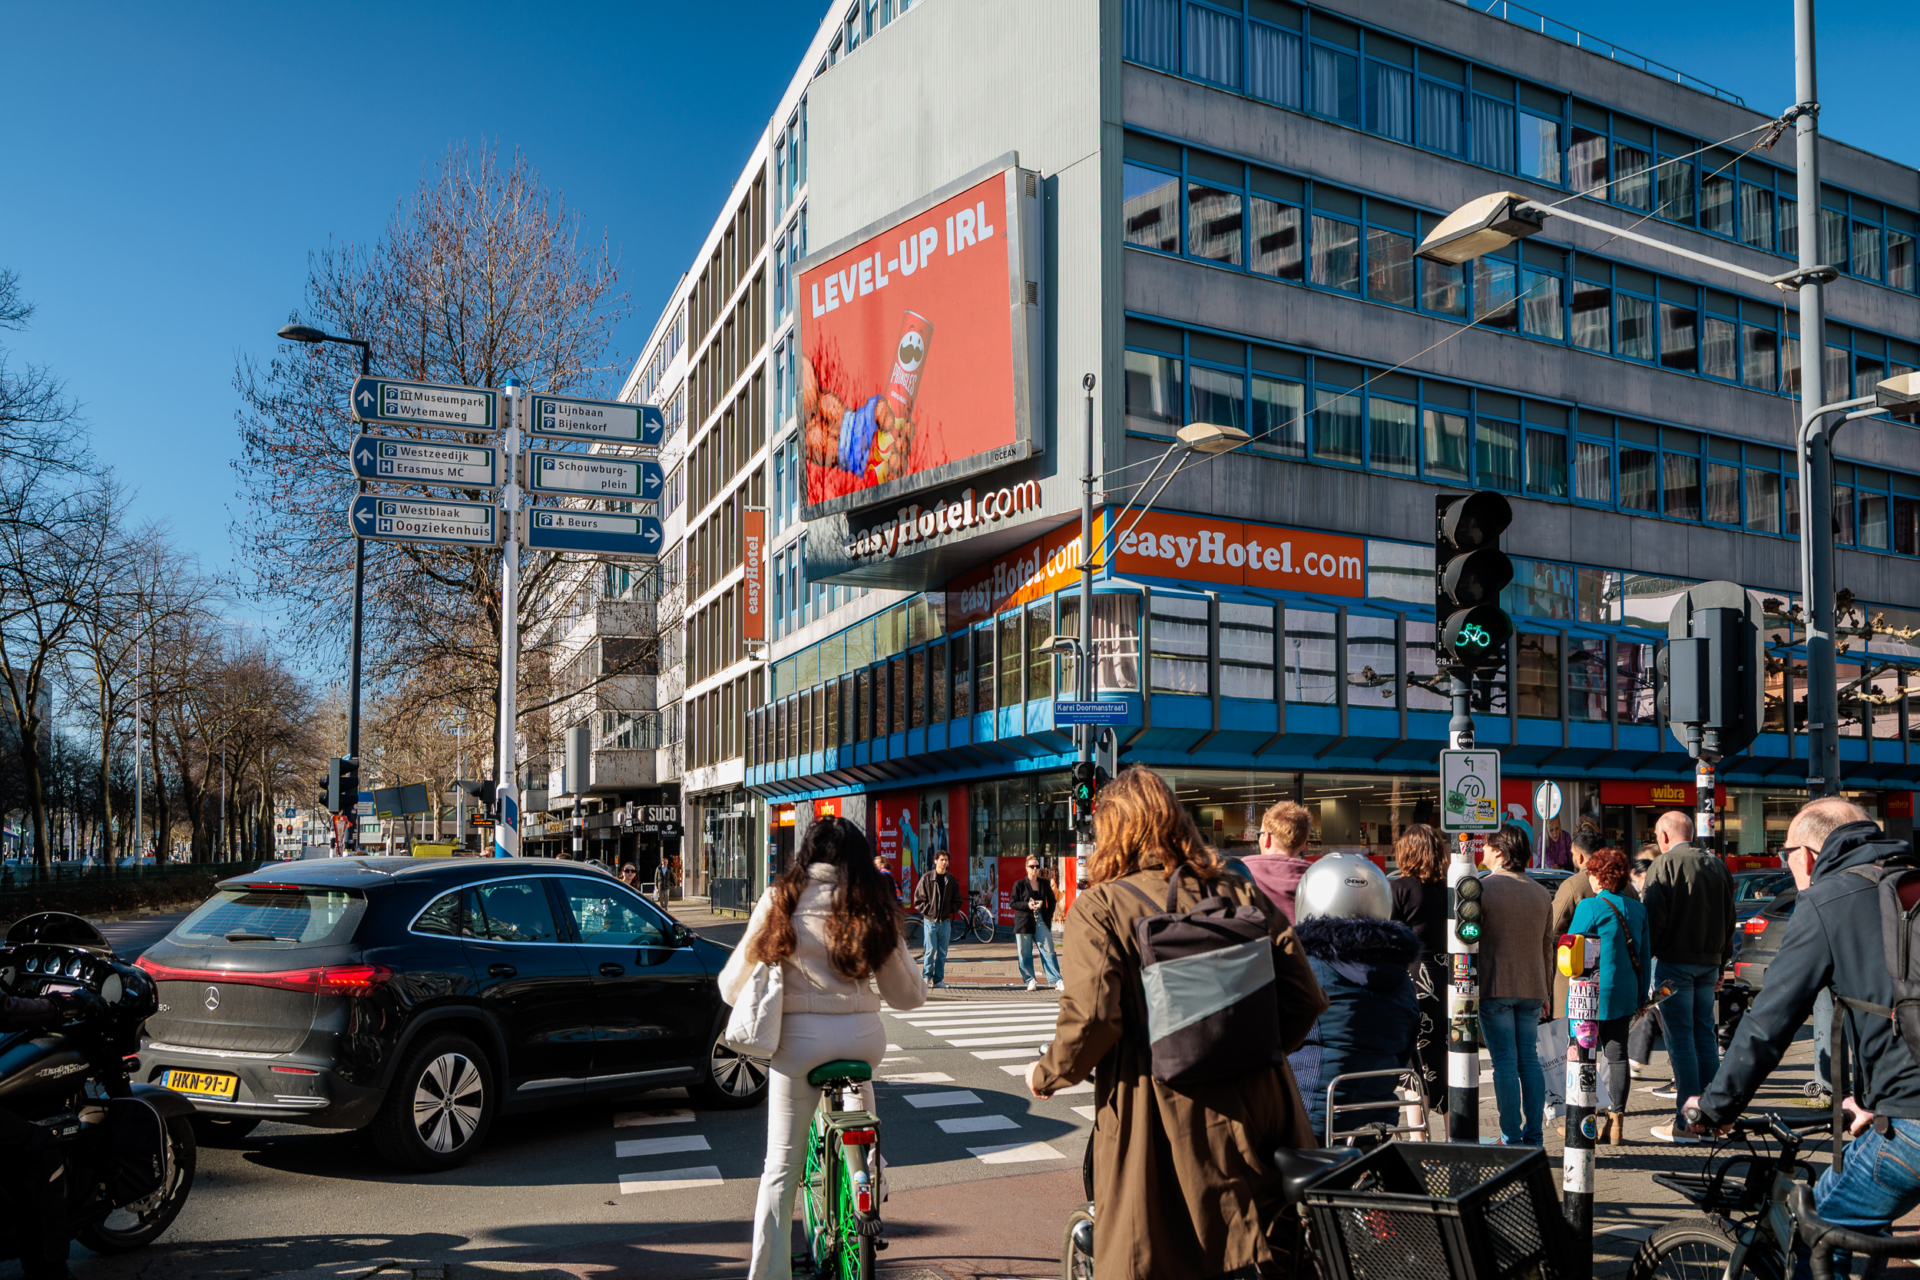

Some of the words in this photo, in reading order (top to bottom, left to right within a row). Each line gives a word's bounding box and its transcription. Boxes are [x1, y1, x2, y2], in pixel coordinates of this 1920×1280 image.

[812, 226, 938, 319] LEVEL-UP
[946, 200, 994, 256] IRL
[890, 362, 918, 396] PRINGLES
[414, 390, 484, 408] Museumpark
[400, 404, 467, 422] Wytemaweg
[558, 405, 604, 418] Lijnbaan
[558, 419, 608, 432] Bijenkorf
[400, 446, 469, 463] Westzeedijk
[994, 449, 1016, 462] OCEAN
[397, 463, 444, 476] Erasmus
[447, 466, 464, 478] MC
[558, 461, 628, 478] Schouwburg-
[601, 478, 628, 490] plein
[400, 504, 460, 518] Westblaak
[396, 520, 490, 537] Oogziekenhuis
[568, 517, 598, 528] Beurs
[844, 480, 1040, 560] easyHotel.com
[1118, 530, 1361, 580] easyHotel.com
[746, 536, 761, 614] easyHotel
[960, 536, 1082, 613] easyHotel.com
[1464, 784, 1479, 798] 70
[1650, 784, 1684, 799] wibra
[171, 1072, 230, 1092] HKN-91-J
